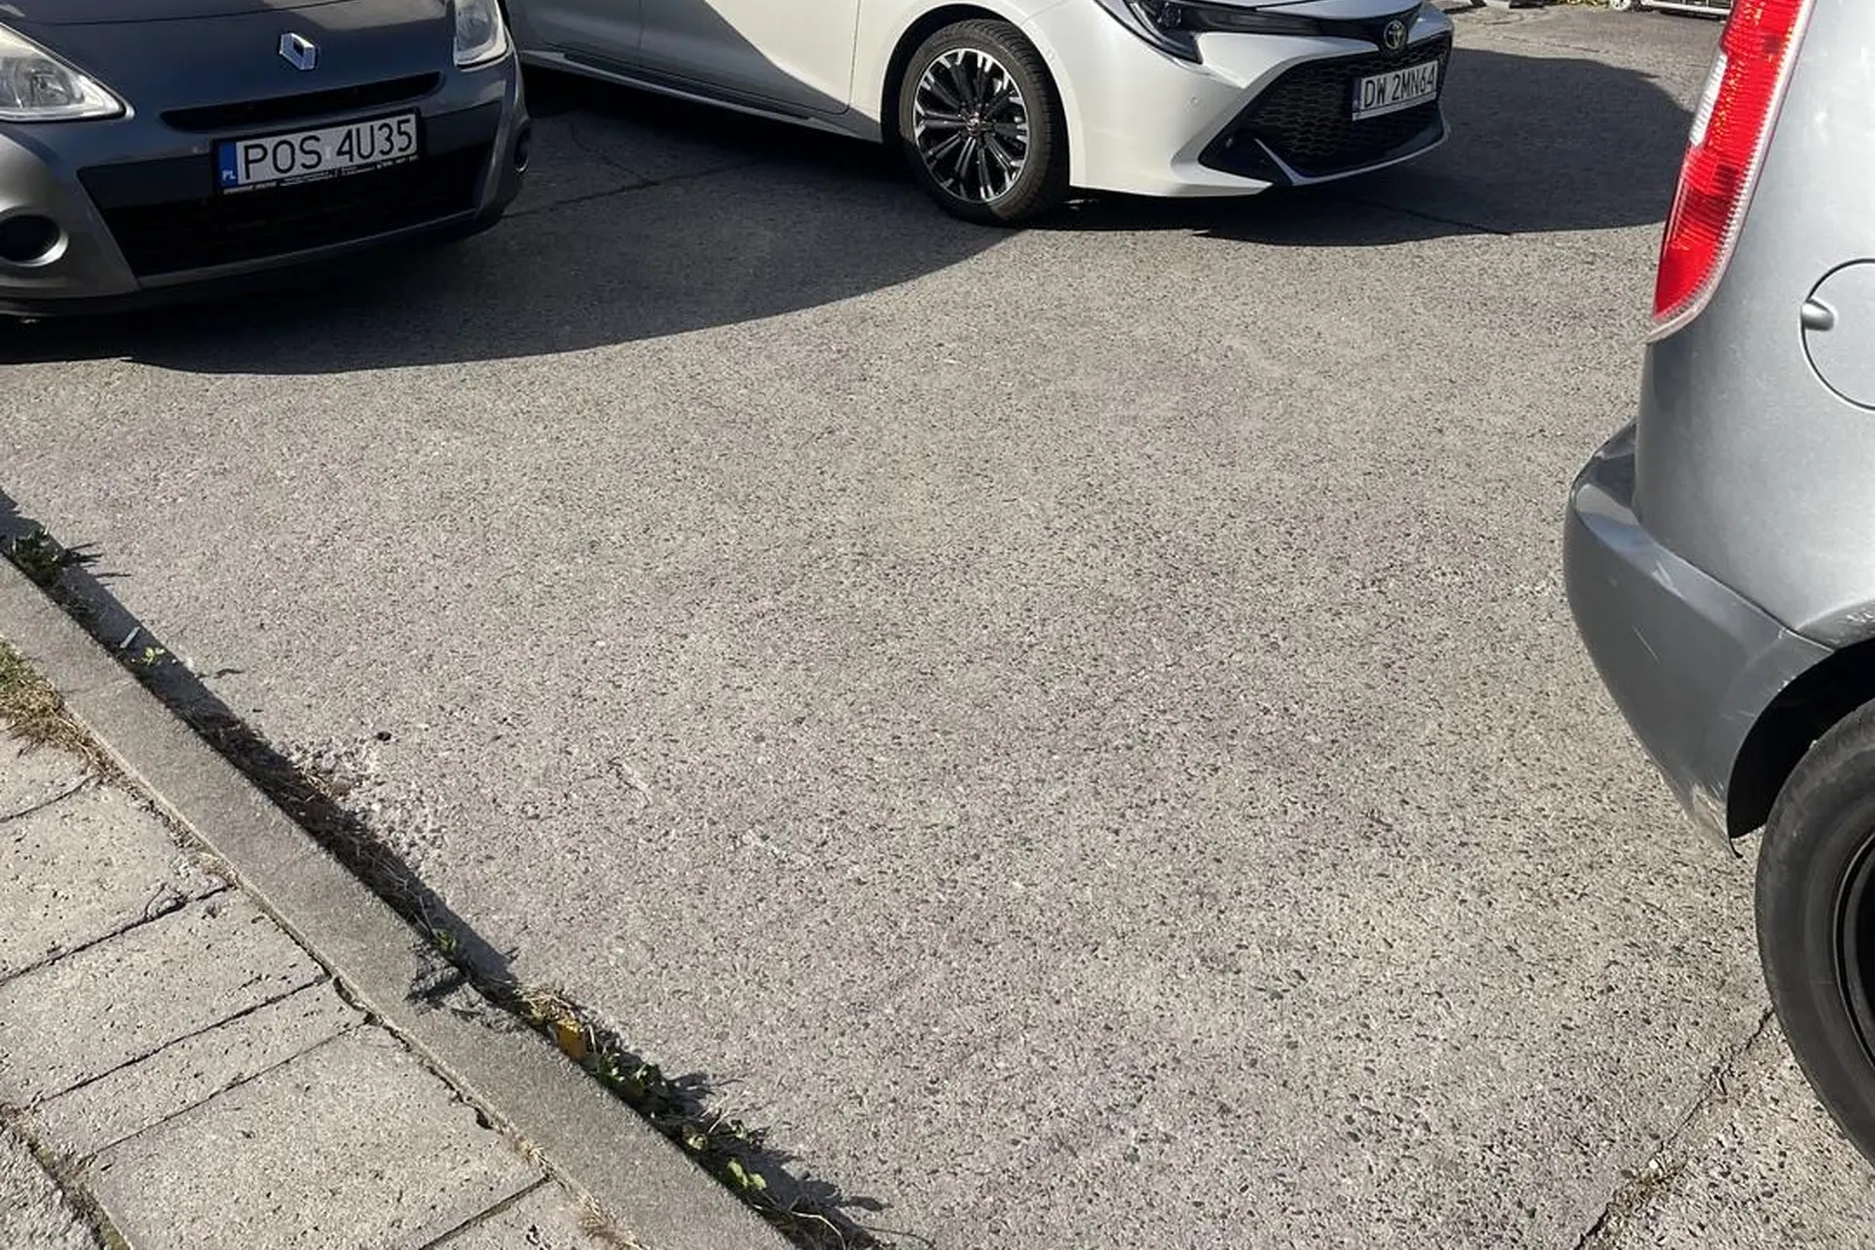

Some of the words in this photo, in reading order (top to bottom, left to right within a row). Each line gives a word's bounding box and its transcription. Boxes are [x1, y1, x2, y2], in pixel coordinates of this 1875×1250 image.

[1364, 78, 1387, 108] DW
[1391, 65, 1436, 101] 2MN64
[243, 135, 322, 180] POS
[336, 118, 412, 163] 4U35
[222, 169, 236, 181] PL
